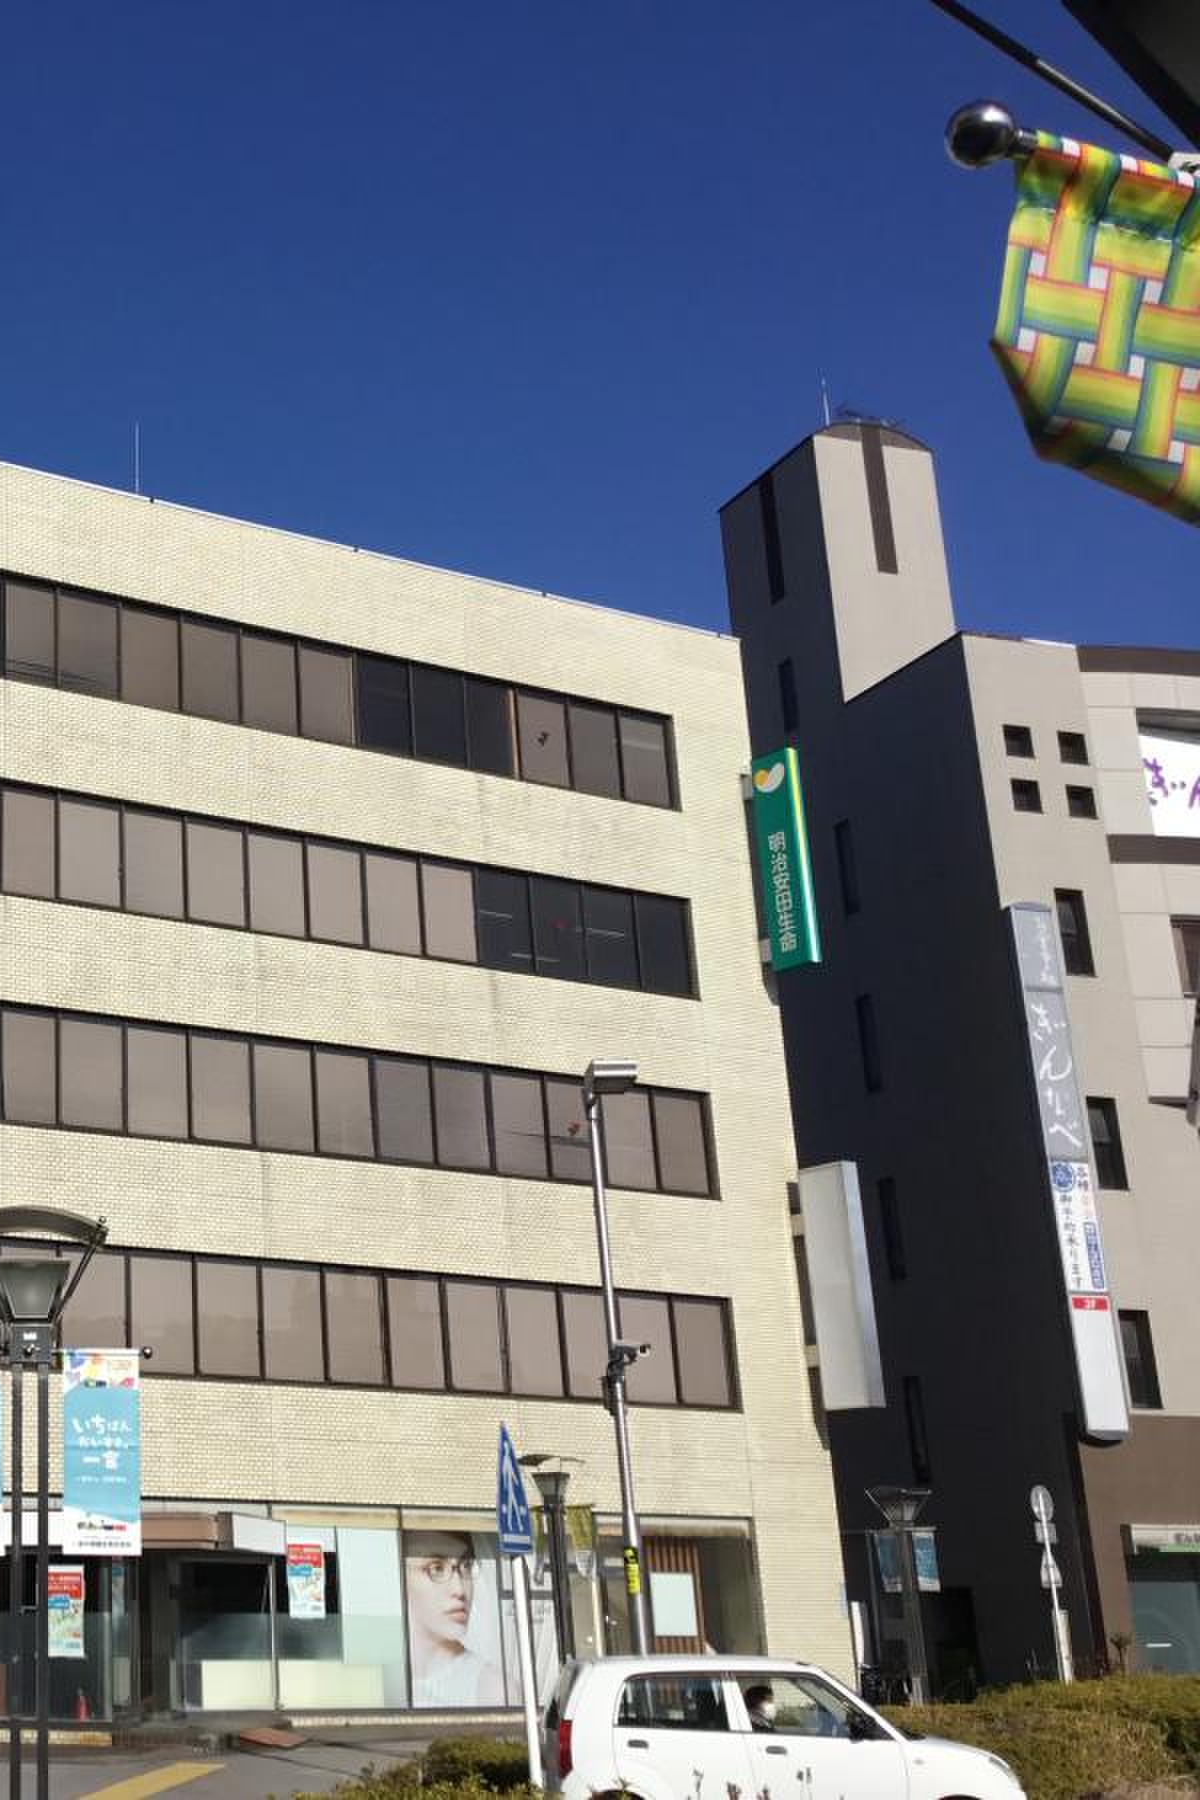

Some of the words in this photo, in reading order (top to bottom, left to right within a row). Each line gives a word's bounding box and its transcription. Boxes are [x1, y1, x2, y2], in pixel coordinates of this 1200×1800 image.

[767, 831, 797, 953] 明治安田生命
